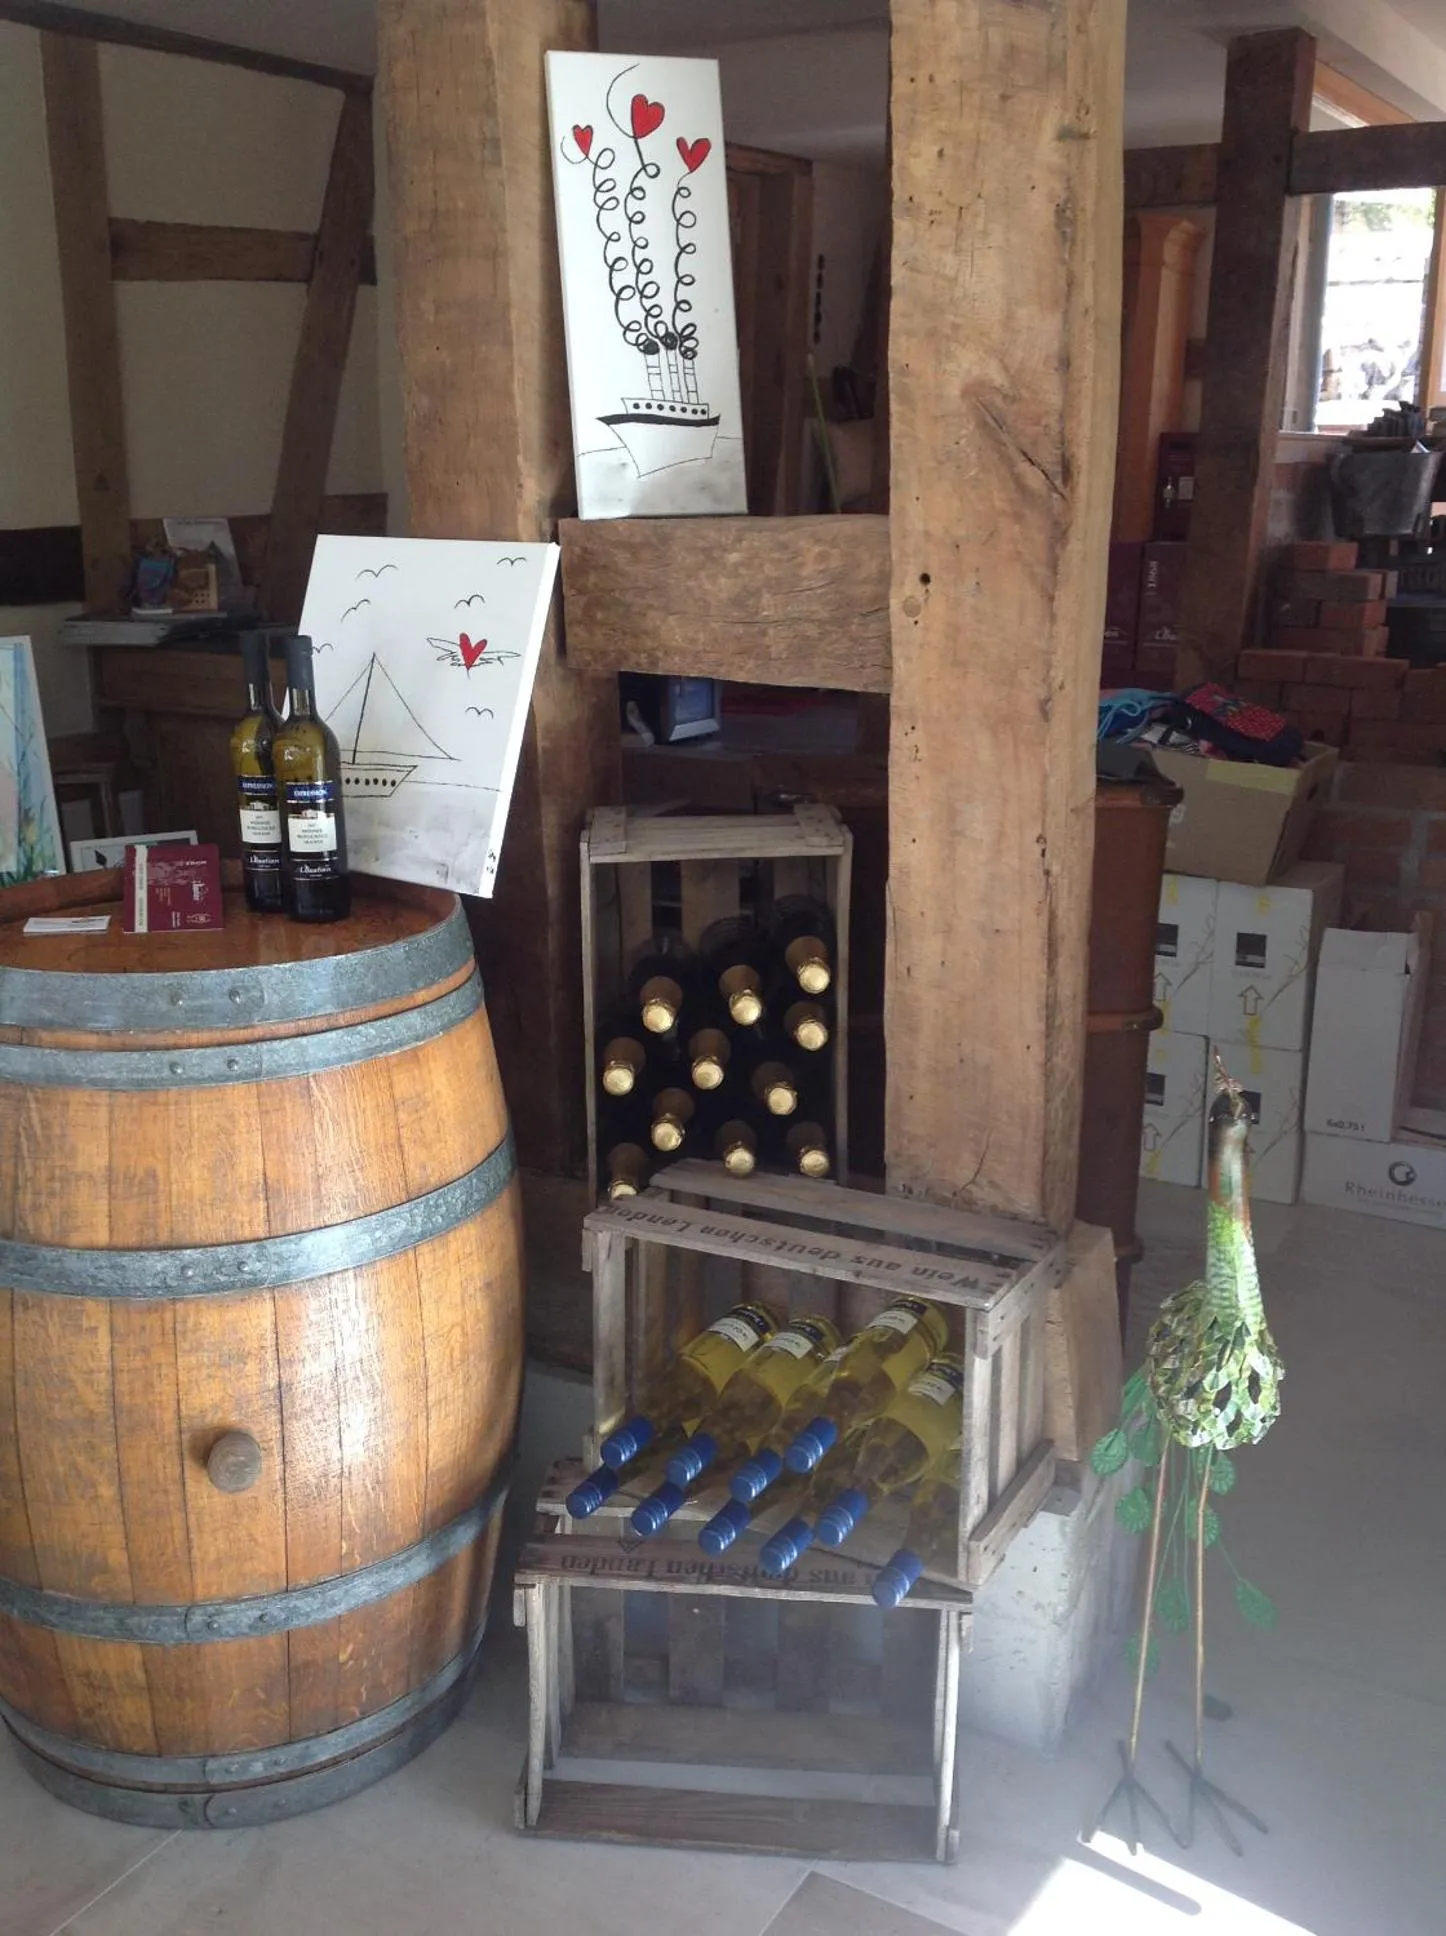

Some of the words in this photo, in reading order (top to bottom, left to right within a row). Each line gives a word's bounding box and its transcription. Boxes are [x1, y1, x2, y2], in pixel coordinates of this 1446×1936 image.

[1344, 1180, 1446, 1207] Rheinhesse
[603, 1206, 693, 1233] Landen
[701, 1224, 840, 1261] deutschen
[850, 1254, 902, 1271] aus
[911, 1266, 980, 1290] Wein
[560, 1553, 657, 1578] Landen
[809, 1567, 854, 1585] aus
